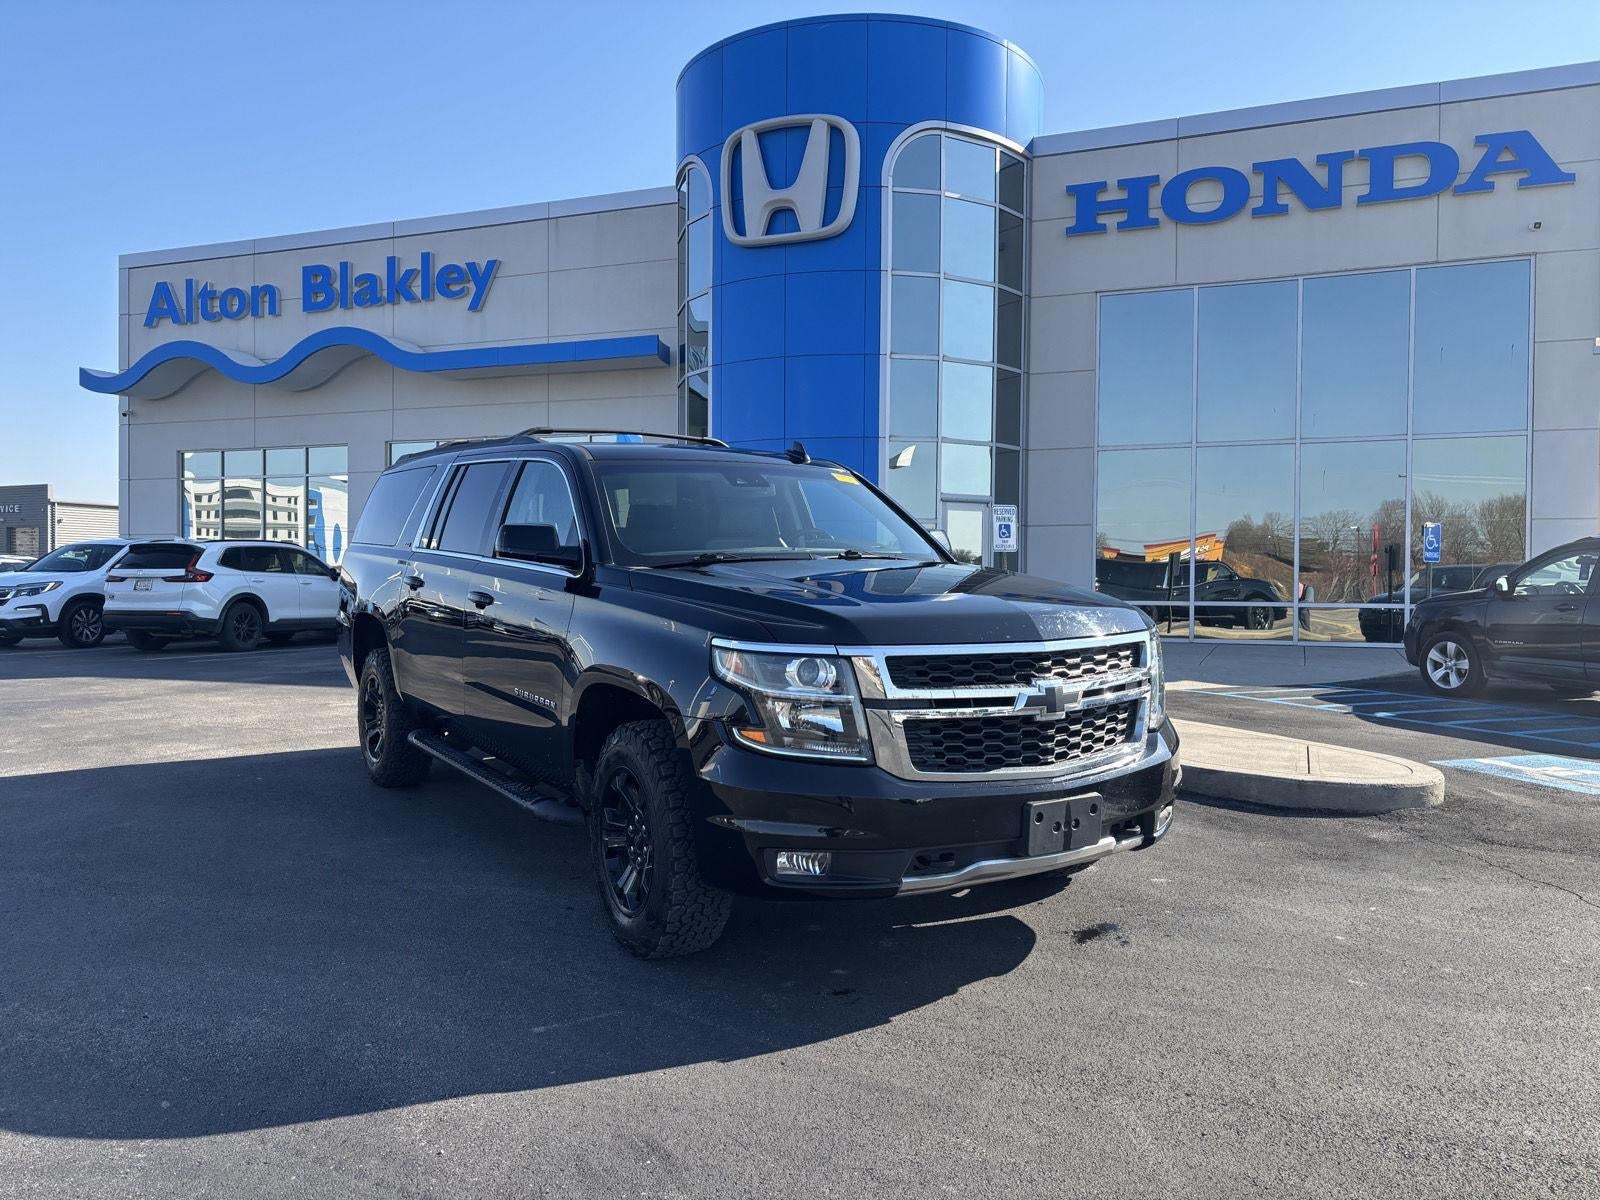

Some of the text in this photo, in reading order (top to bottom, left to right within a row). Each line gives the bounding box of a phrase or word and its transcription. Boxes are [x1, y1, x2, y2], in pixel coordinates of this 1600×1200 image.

[1066, 130, 1577, 238] HONDA
[143, 251, 501, 328] Alton Blakley
[993, 508, 1015, 516] RESERVED
[513, 687, 556, 709] SUBURBAN
